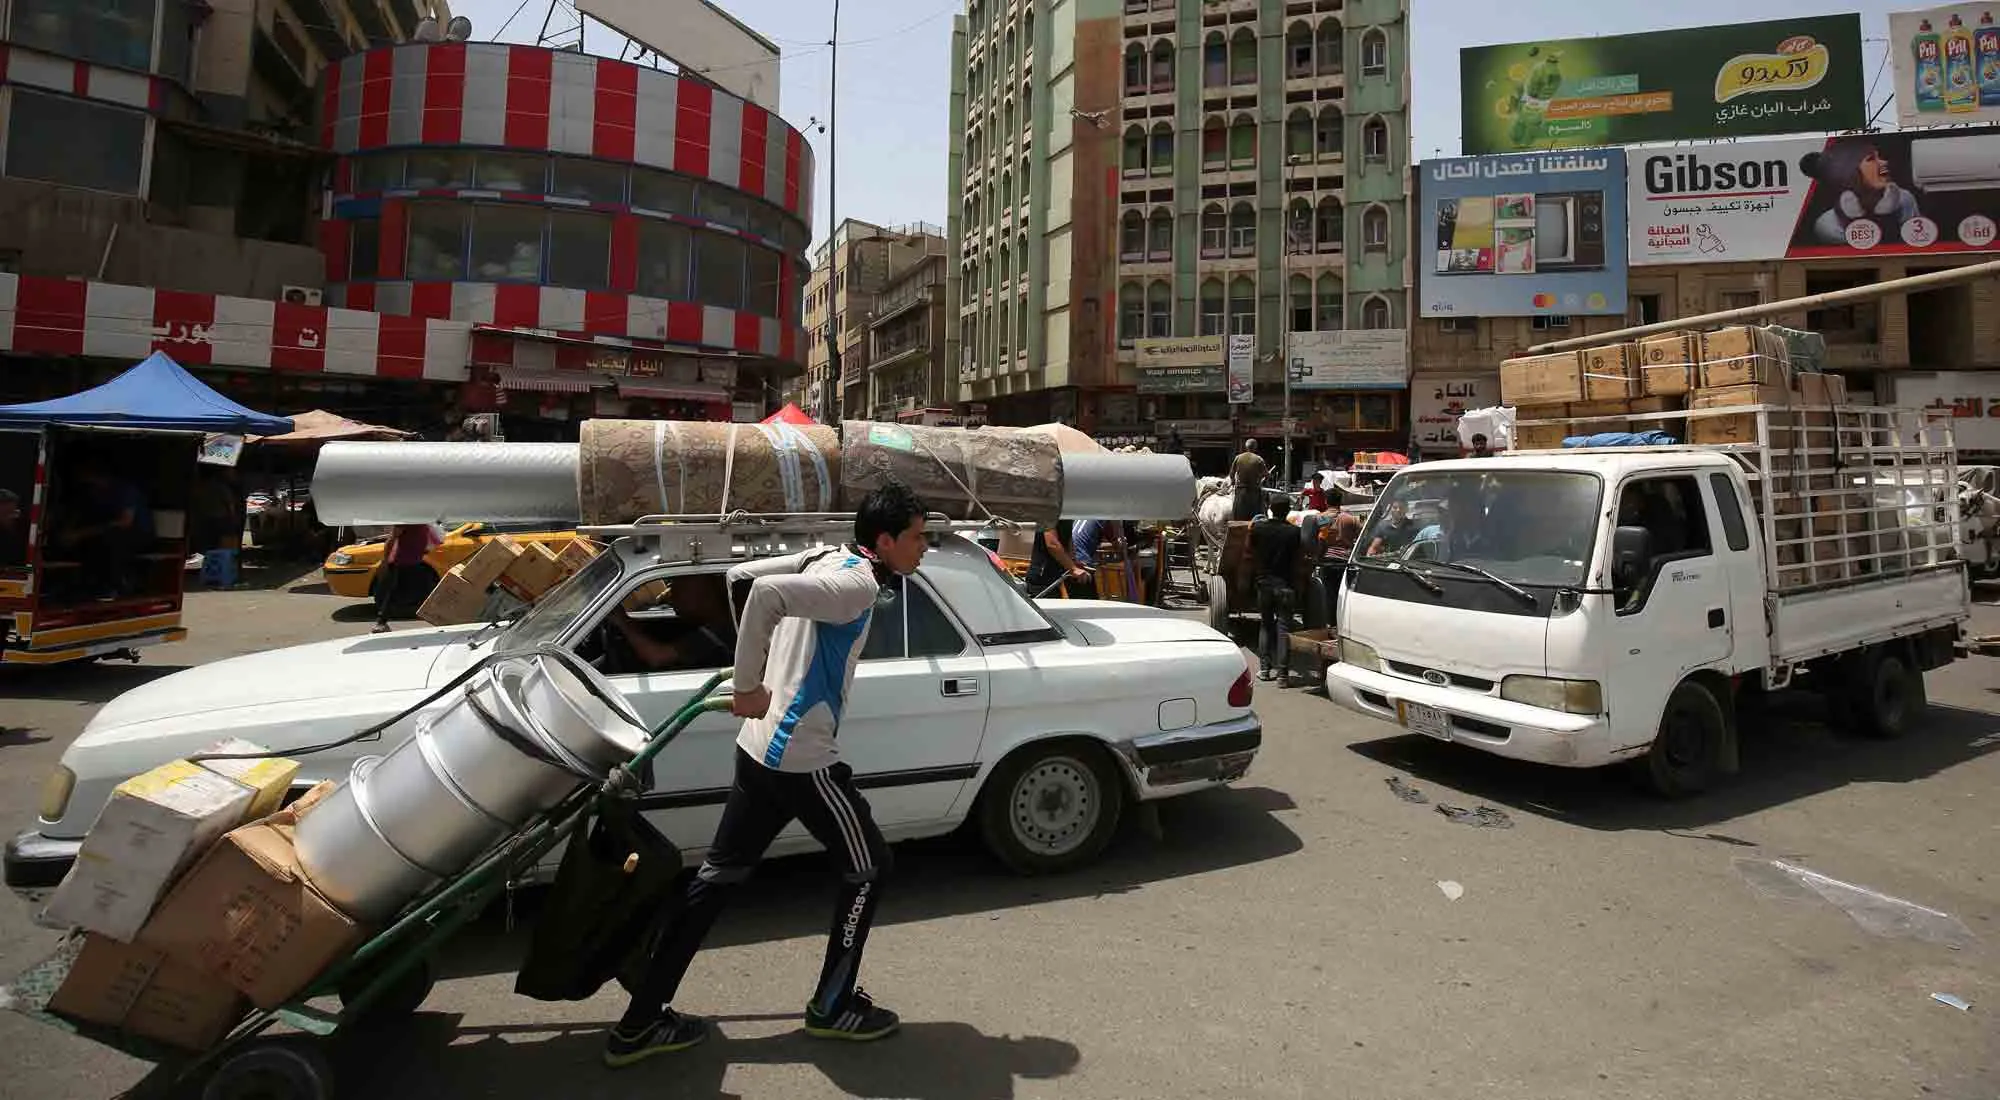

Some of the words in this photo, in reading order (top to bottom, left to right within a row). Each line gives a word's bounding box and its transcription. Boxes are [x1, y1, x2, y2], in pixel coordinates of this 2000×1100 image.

[1919, 40, 1937, 58] Pril
[1948, 39, 1967, 56] Pril
[1980, 35, 1999, 53] Pril
[1715, 103, 1750, 124] غازي
[1787, 98, 1832, 115] شراب
[1433, 161, 1480, 181] الحال
[1484, 158, 1535, 178] تعدل
[1539, 156, 1608, 174] سلفتنا
[1645, 154, 1788, 194] Gibson
[1663, 204, 1702, 217] جبسون
[1706, 200, 1742, 214] تكييف
[1743, 195, 1775, 213] أجهزة
[1648, 224, 1690, 237] الصيانة
[1913, 220, 1923, 233] 3
[1648, 237, 1690, 249] المجانية
[843, 895, 866, 948] adidas
